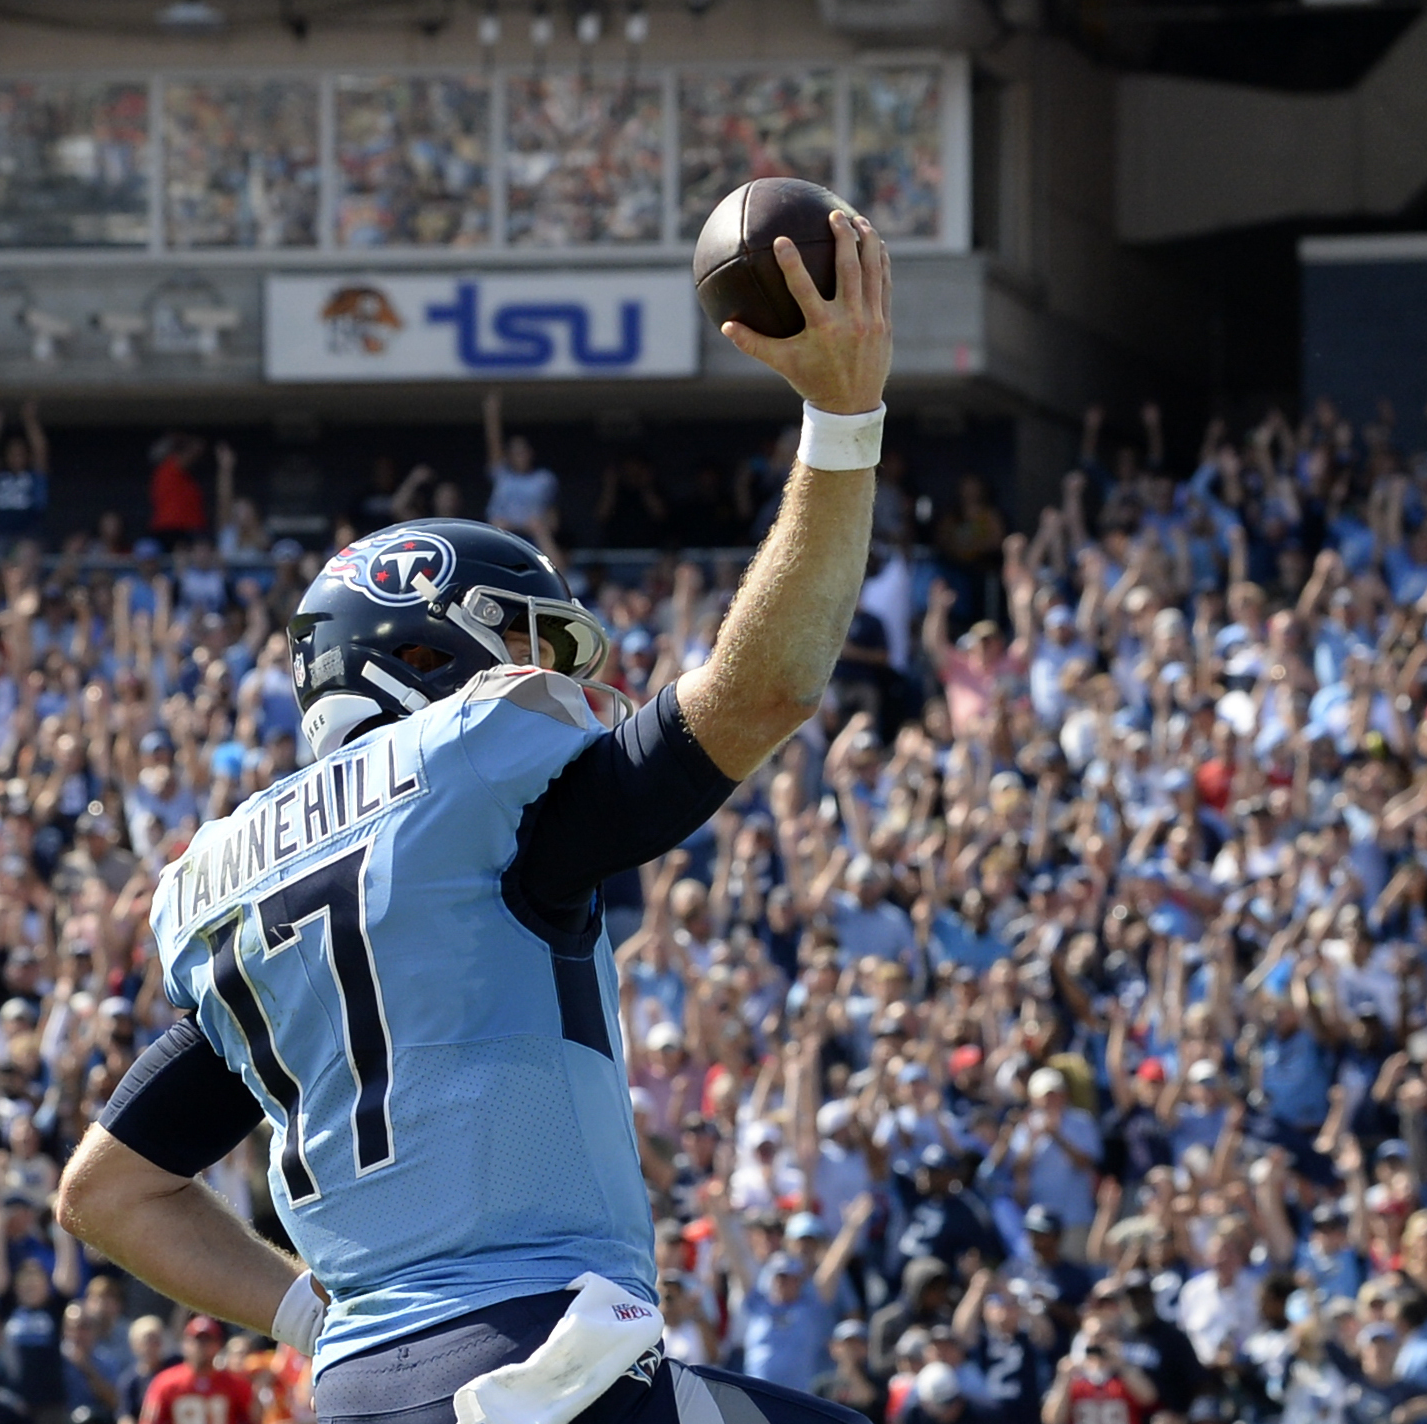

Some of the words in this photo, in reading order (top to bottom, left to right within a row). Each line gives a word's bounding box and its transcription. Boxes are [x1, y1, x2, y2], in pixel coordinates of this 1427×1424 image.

[426, 281, 641, 369] tsu
[170, 735, 423, 930] TANNEHILL
[203, 834, 396, 1209] 17
